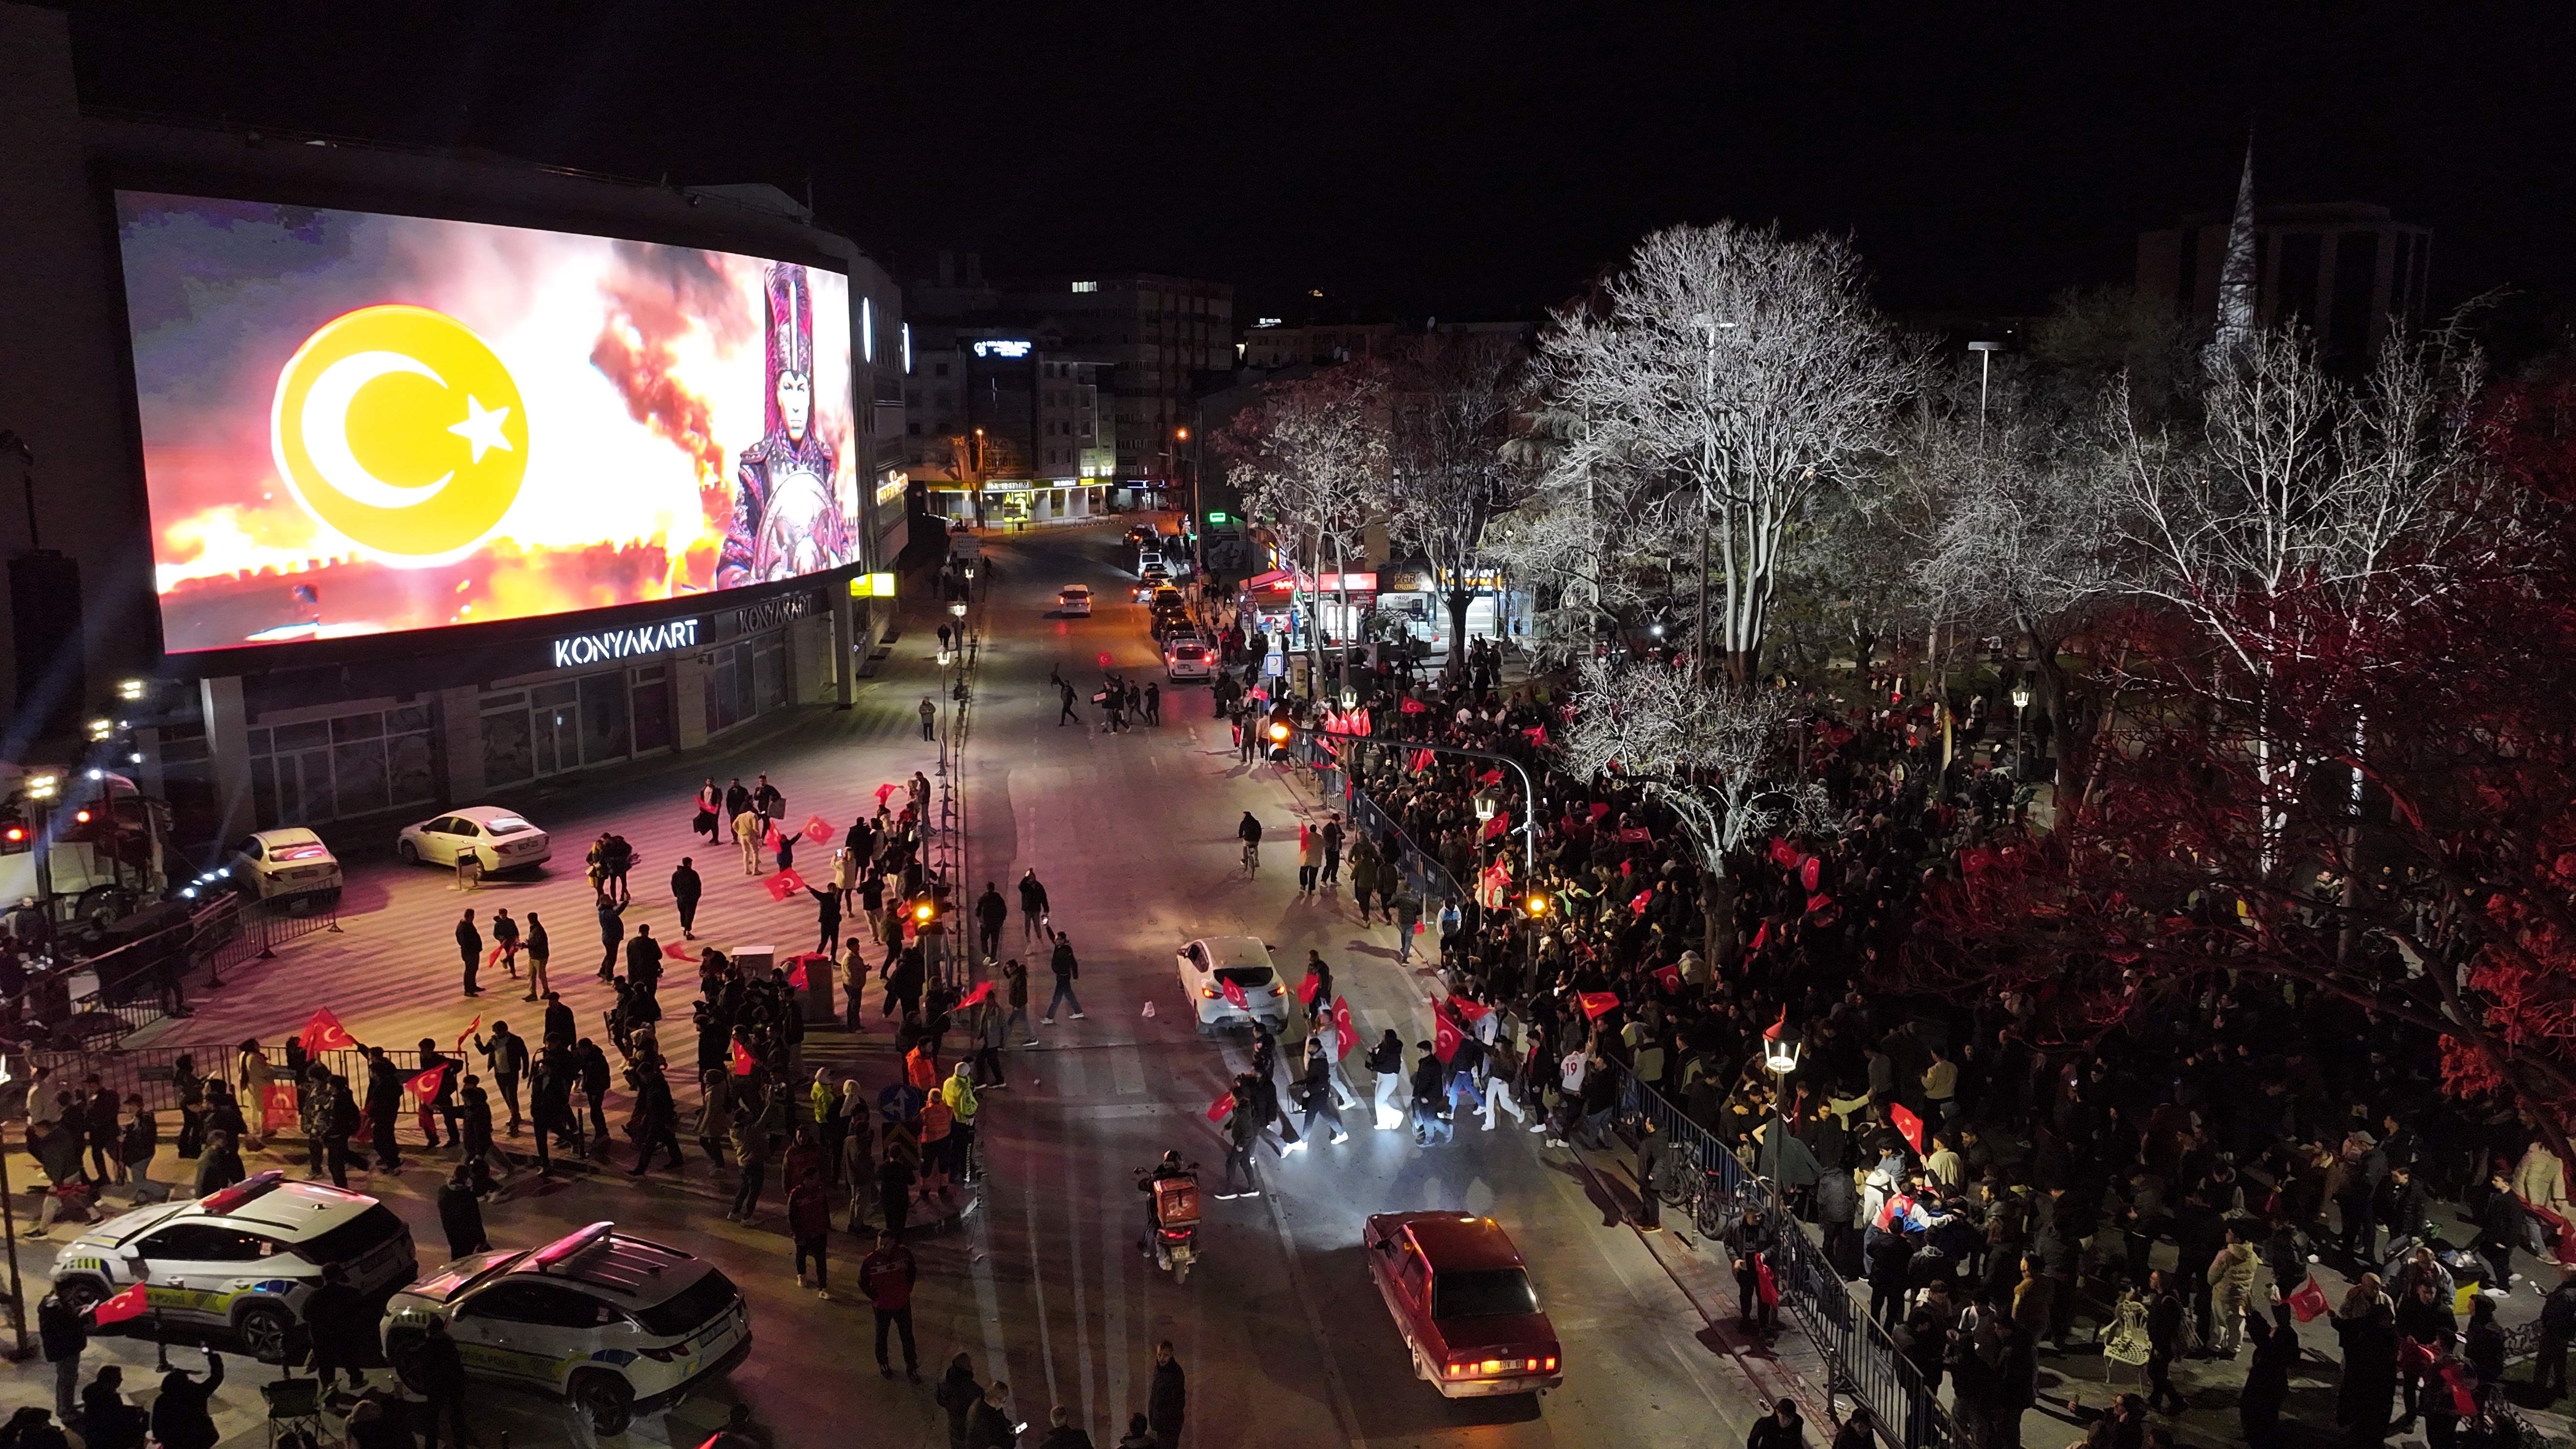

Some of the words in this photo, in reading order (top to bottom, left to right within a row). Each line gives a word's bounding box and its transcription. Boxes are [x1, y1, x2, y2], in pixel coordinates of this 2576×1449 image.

[740, 594, 812, 634] KONYAKART
[555, 619, 698, 667] KONYAKART
[1566, 1062, 1577, 1076] 19
